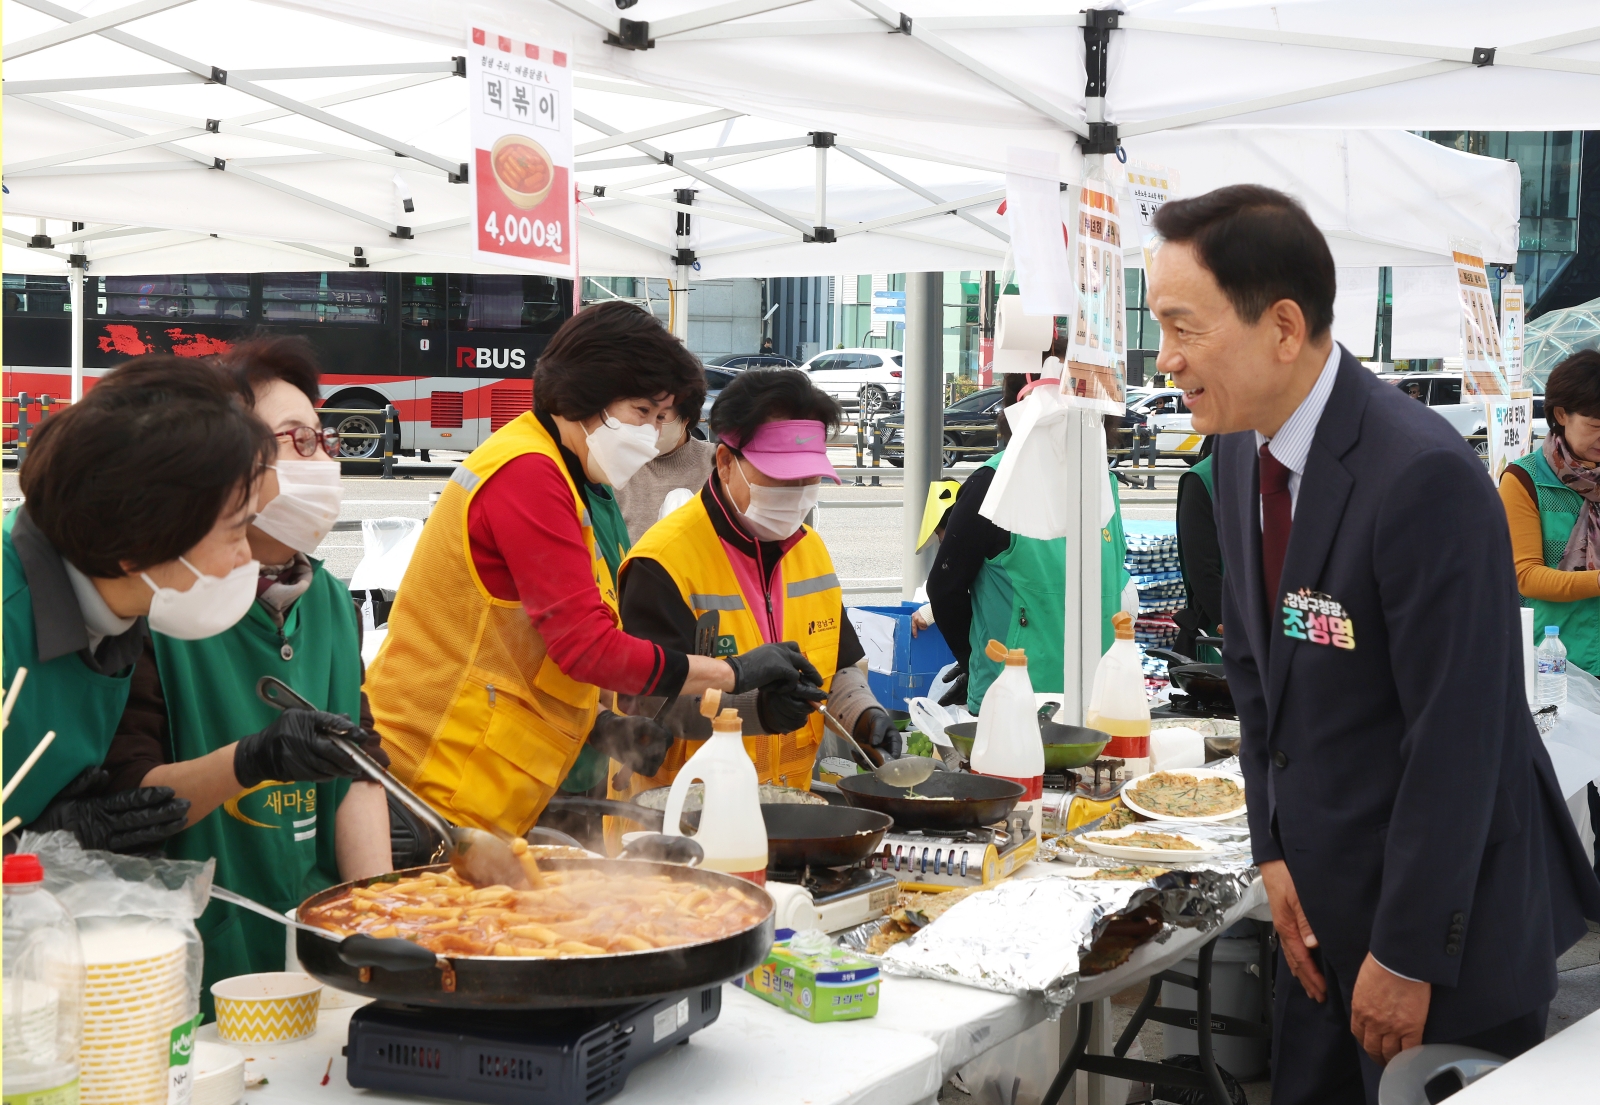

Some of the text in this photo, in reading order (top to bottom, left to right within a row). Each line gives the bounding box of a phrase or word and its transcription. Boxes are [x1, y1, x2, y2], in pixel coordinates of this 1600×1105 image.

[487, 80, 555, 123] 떡볶이
[484, 210, 563, 254] 4,000원
[456, 346, 526, 370] RBUS
[1495, 404, 1526, 426] 먹거리 티켓
[1504, 428, 1520, 447] 교환소
[1287, 592, 1342, 617] 강남구청장
[816, 617, 835, 632] 강남구
[1282, 606, 1356, 650] 조성명
[262, 788, 316, 815] 새마을
[762, 969, 794, 997] 크린백
[831, 993, 864, 1006] 크린백
